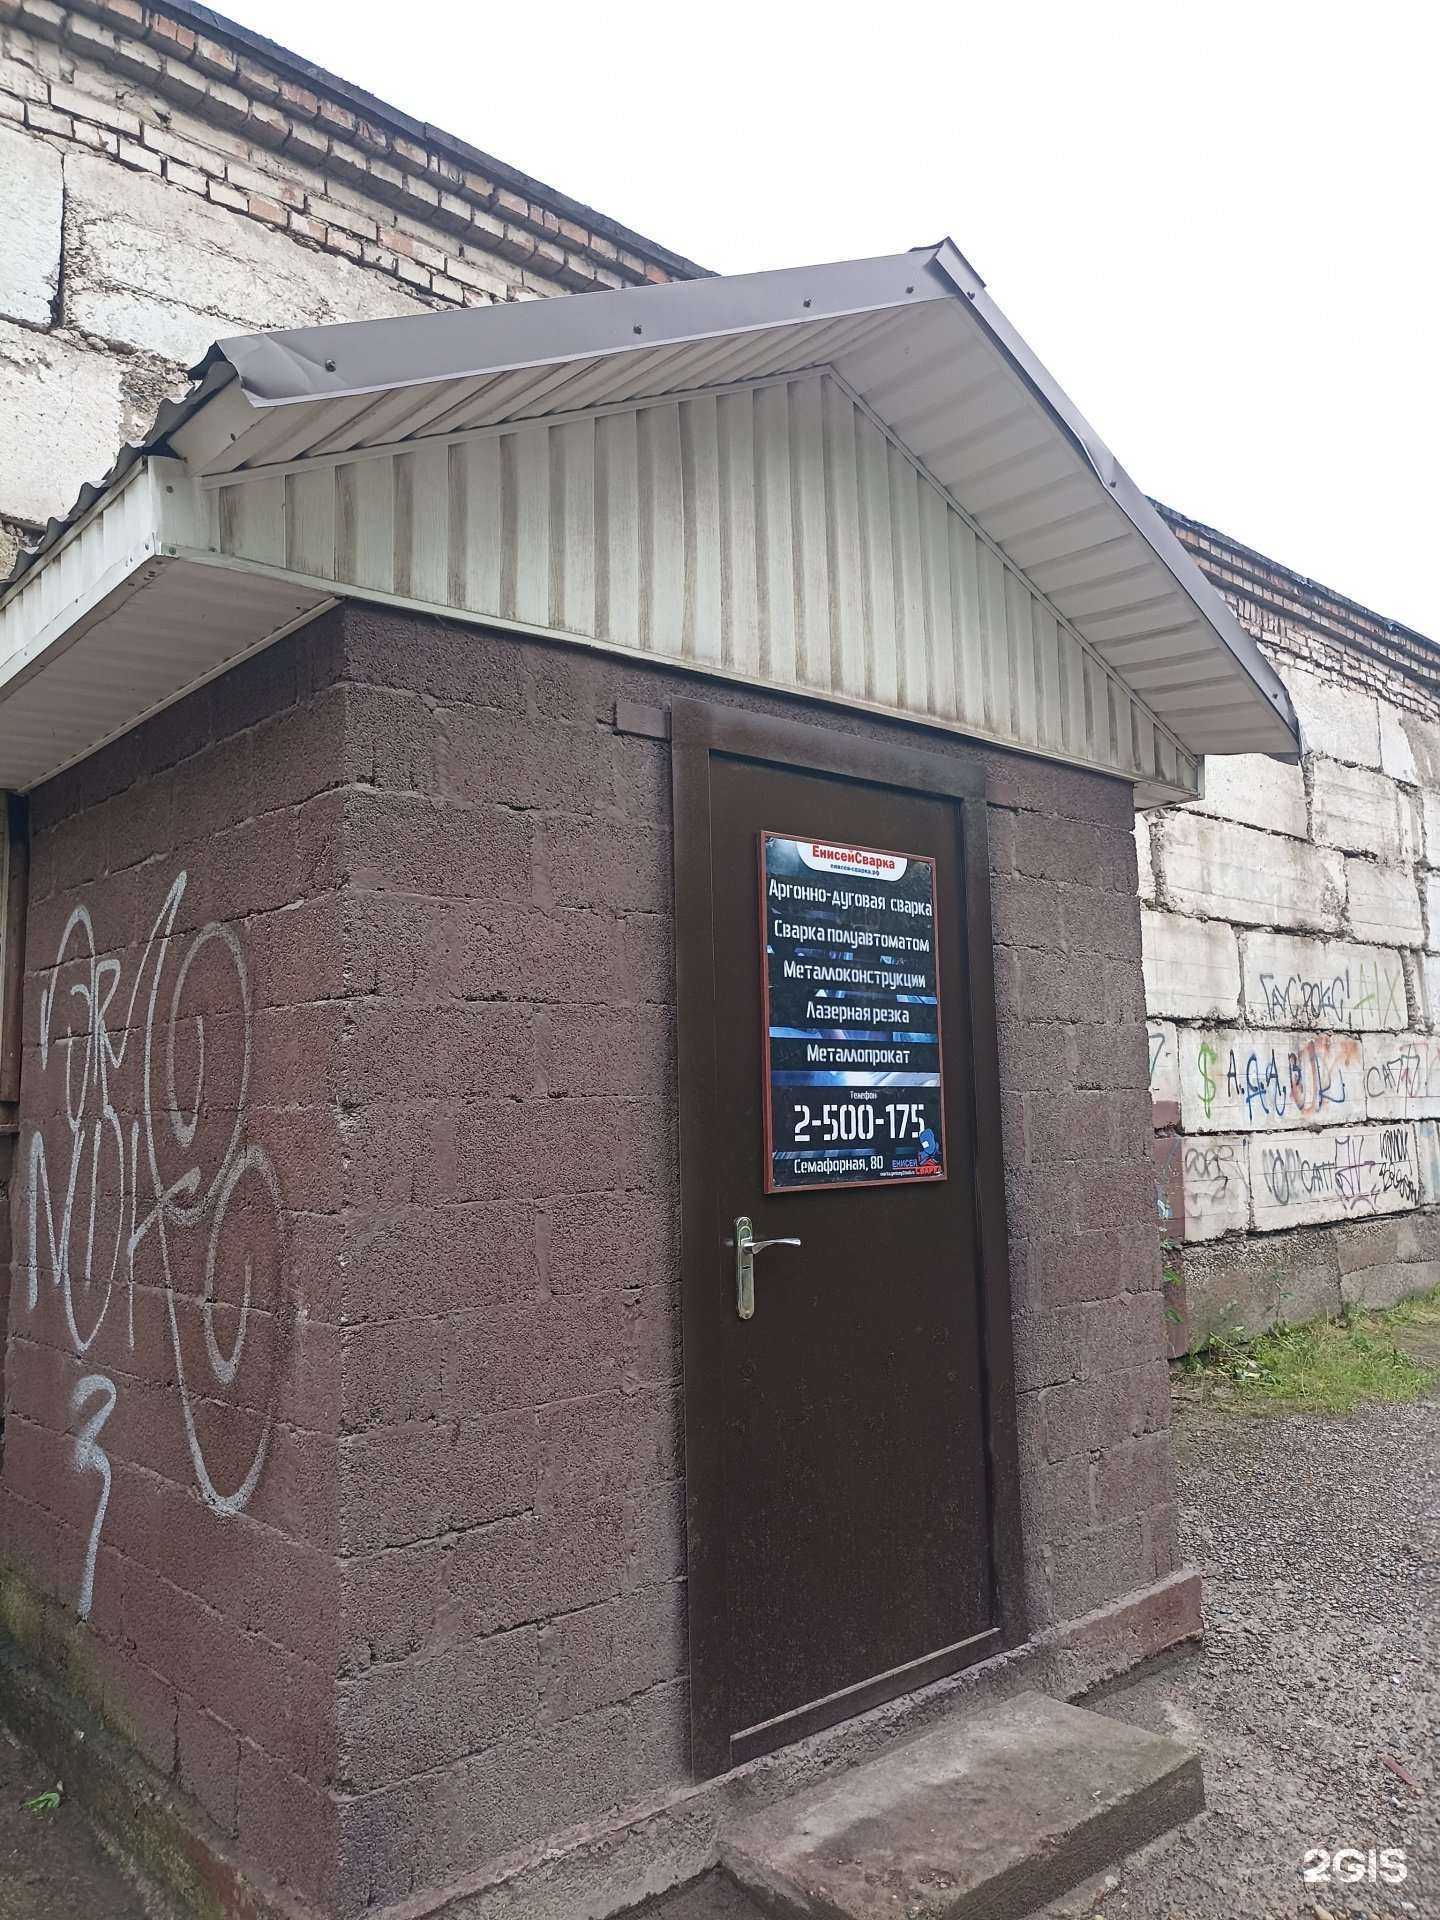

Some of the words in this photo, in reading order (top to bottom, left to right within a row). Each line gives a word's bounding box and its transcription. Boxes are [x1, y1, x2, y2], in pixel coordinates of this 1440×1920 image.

[812, 845, 895, 869] ЕнисейСварка
[769, 879, 885, 910] Аргонно-дуговая
[890, 898, 933, 917] сварка
[774, 920, 825, 942] Сварка
[827, 928, 930, 952] полуавтоматом
[784, 960, 926, 989] Металлоконструкции
[806, 1001, 871, 1023] Лазерная
[873, 1008, 910, 1024] резка
[806, 1044, 910, 1066] Металлопрокат
[850, 1091, 878, 1100] Телефон
[794, 1103, 925, 1142] 2-500-175
[794, 1158, 869, 1175] Семафорная,
[870, 1155, 884, 1170] 80
